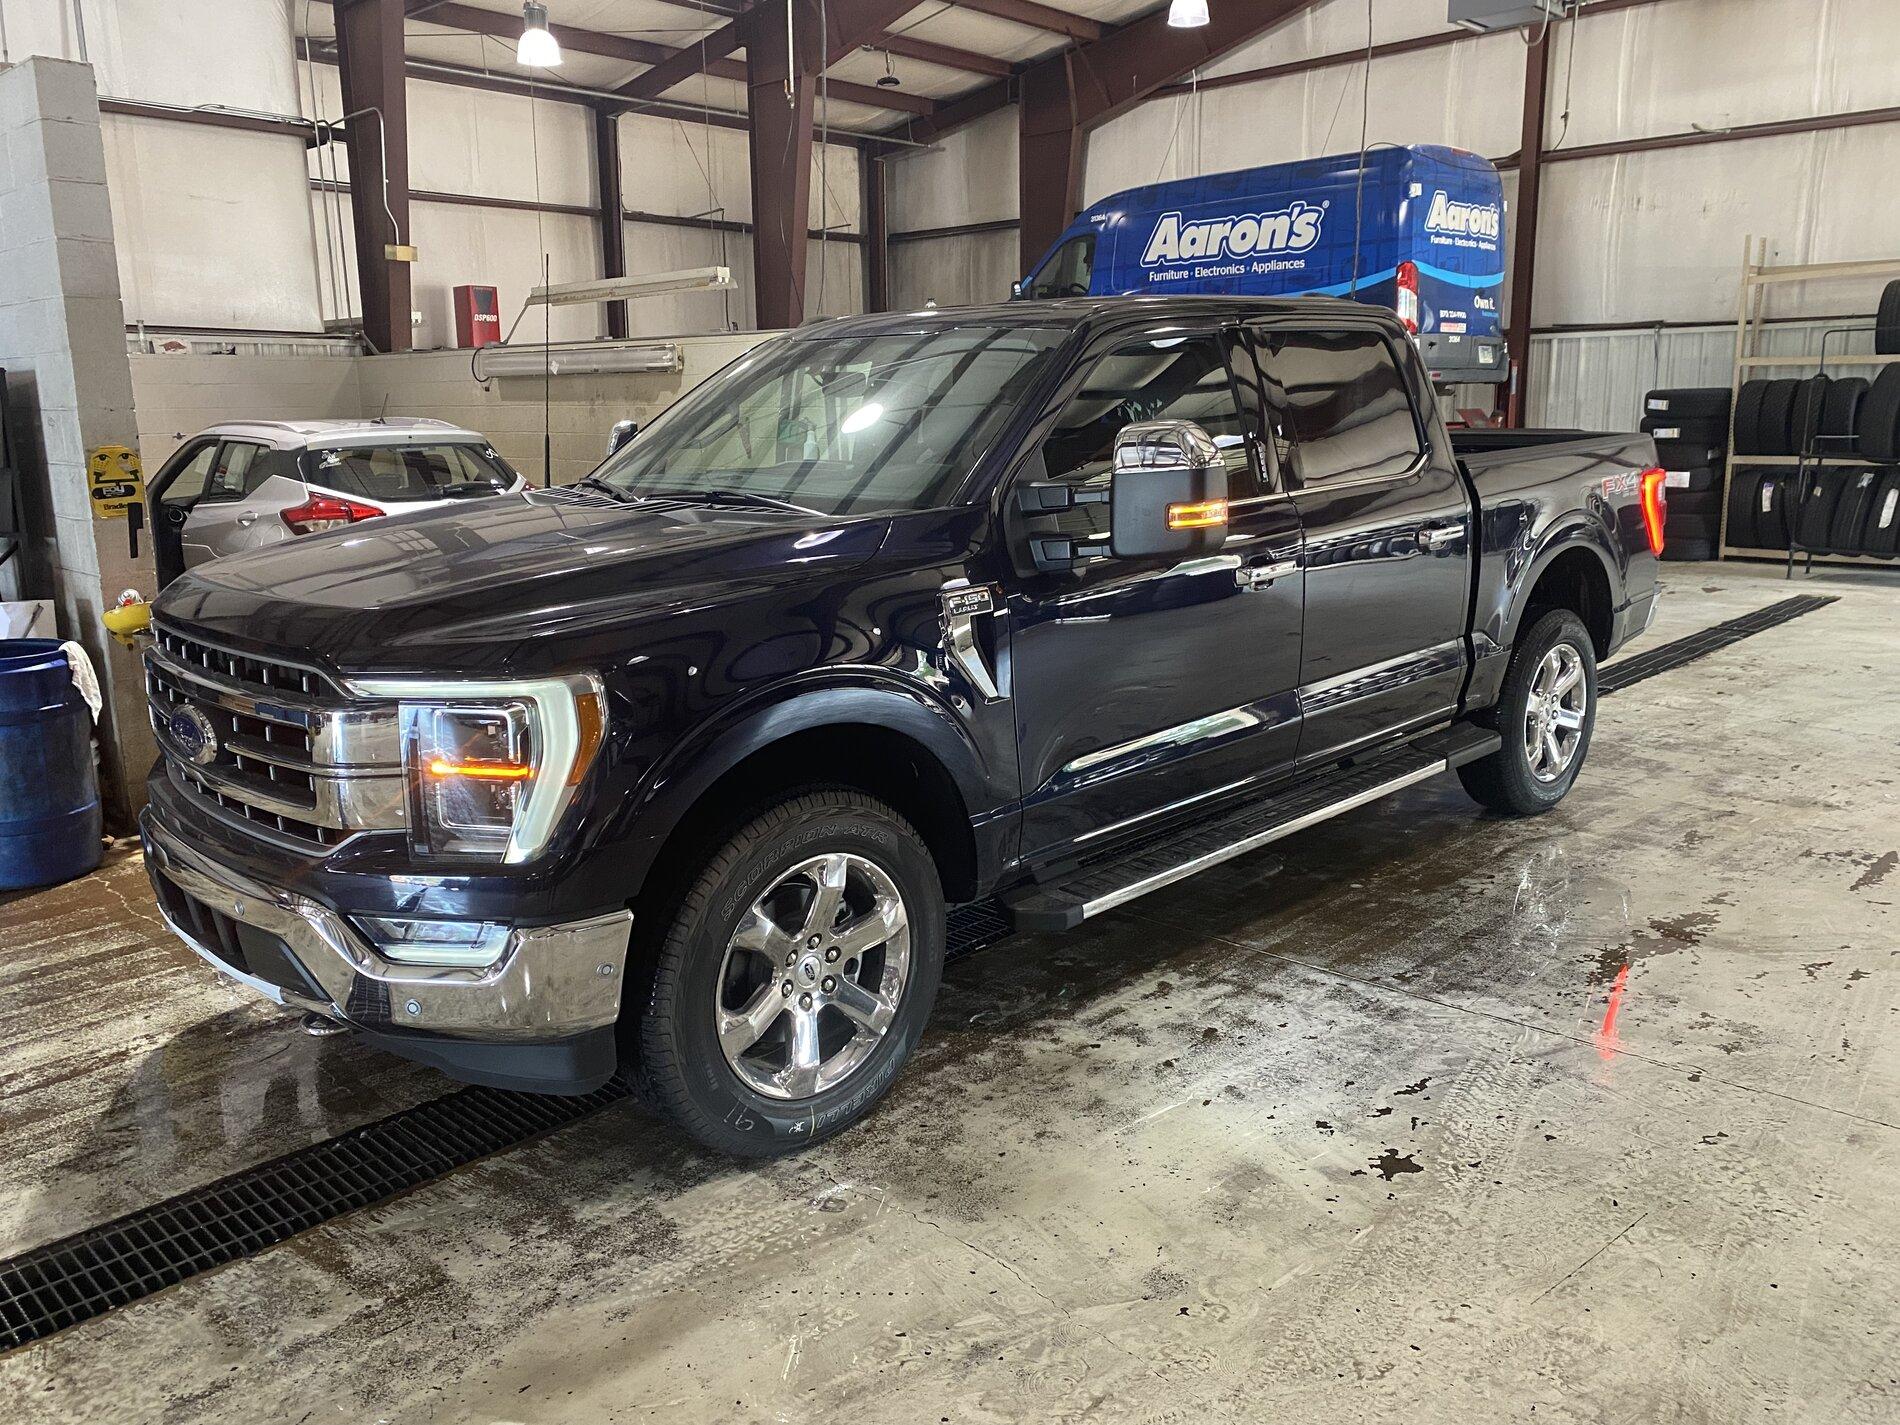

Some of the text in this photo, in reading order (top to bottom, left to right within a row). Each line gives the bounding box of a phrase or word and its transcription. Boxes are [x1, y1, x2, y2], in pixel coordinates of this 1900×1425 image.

[1426, 192, 1499, 238] Aaron's
[1143, 204, 1321, 264] Aaron's
[1149, 259, 1305, 282] Furniture Electronics Appliances
[474, 313, 498, 322] DSP600
[1602, 471, 1637, 501] FX4
[103, 502, 128, 511] Bradle
[948, 591, 990, 608] F-150
[720, 823, 888, 921] SCORPION ATR
[816, 1057, 896, 1129] PIRELLI
